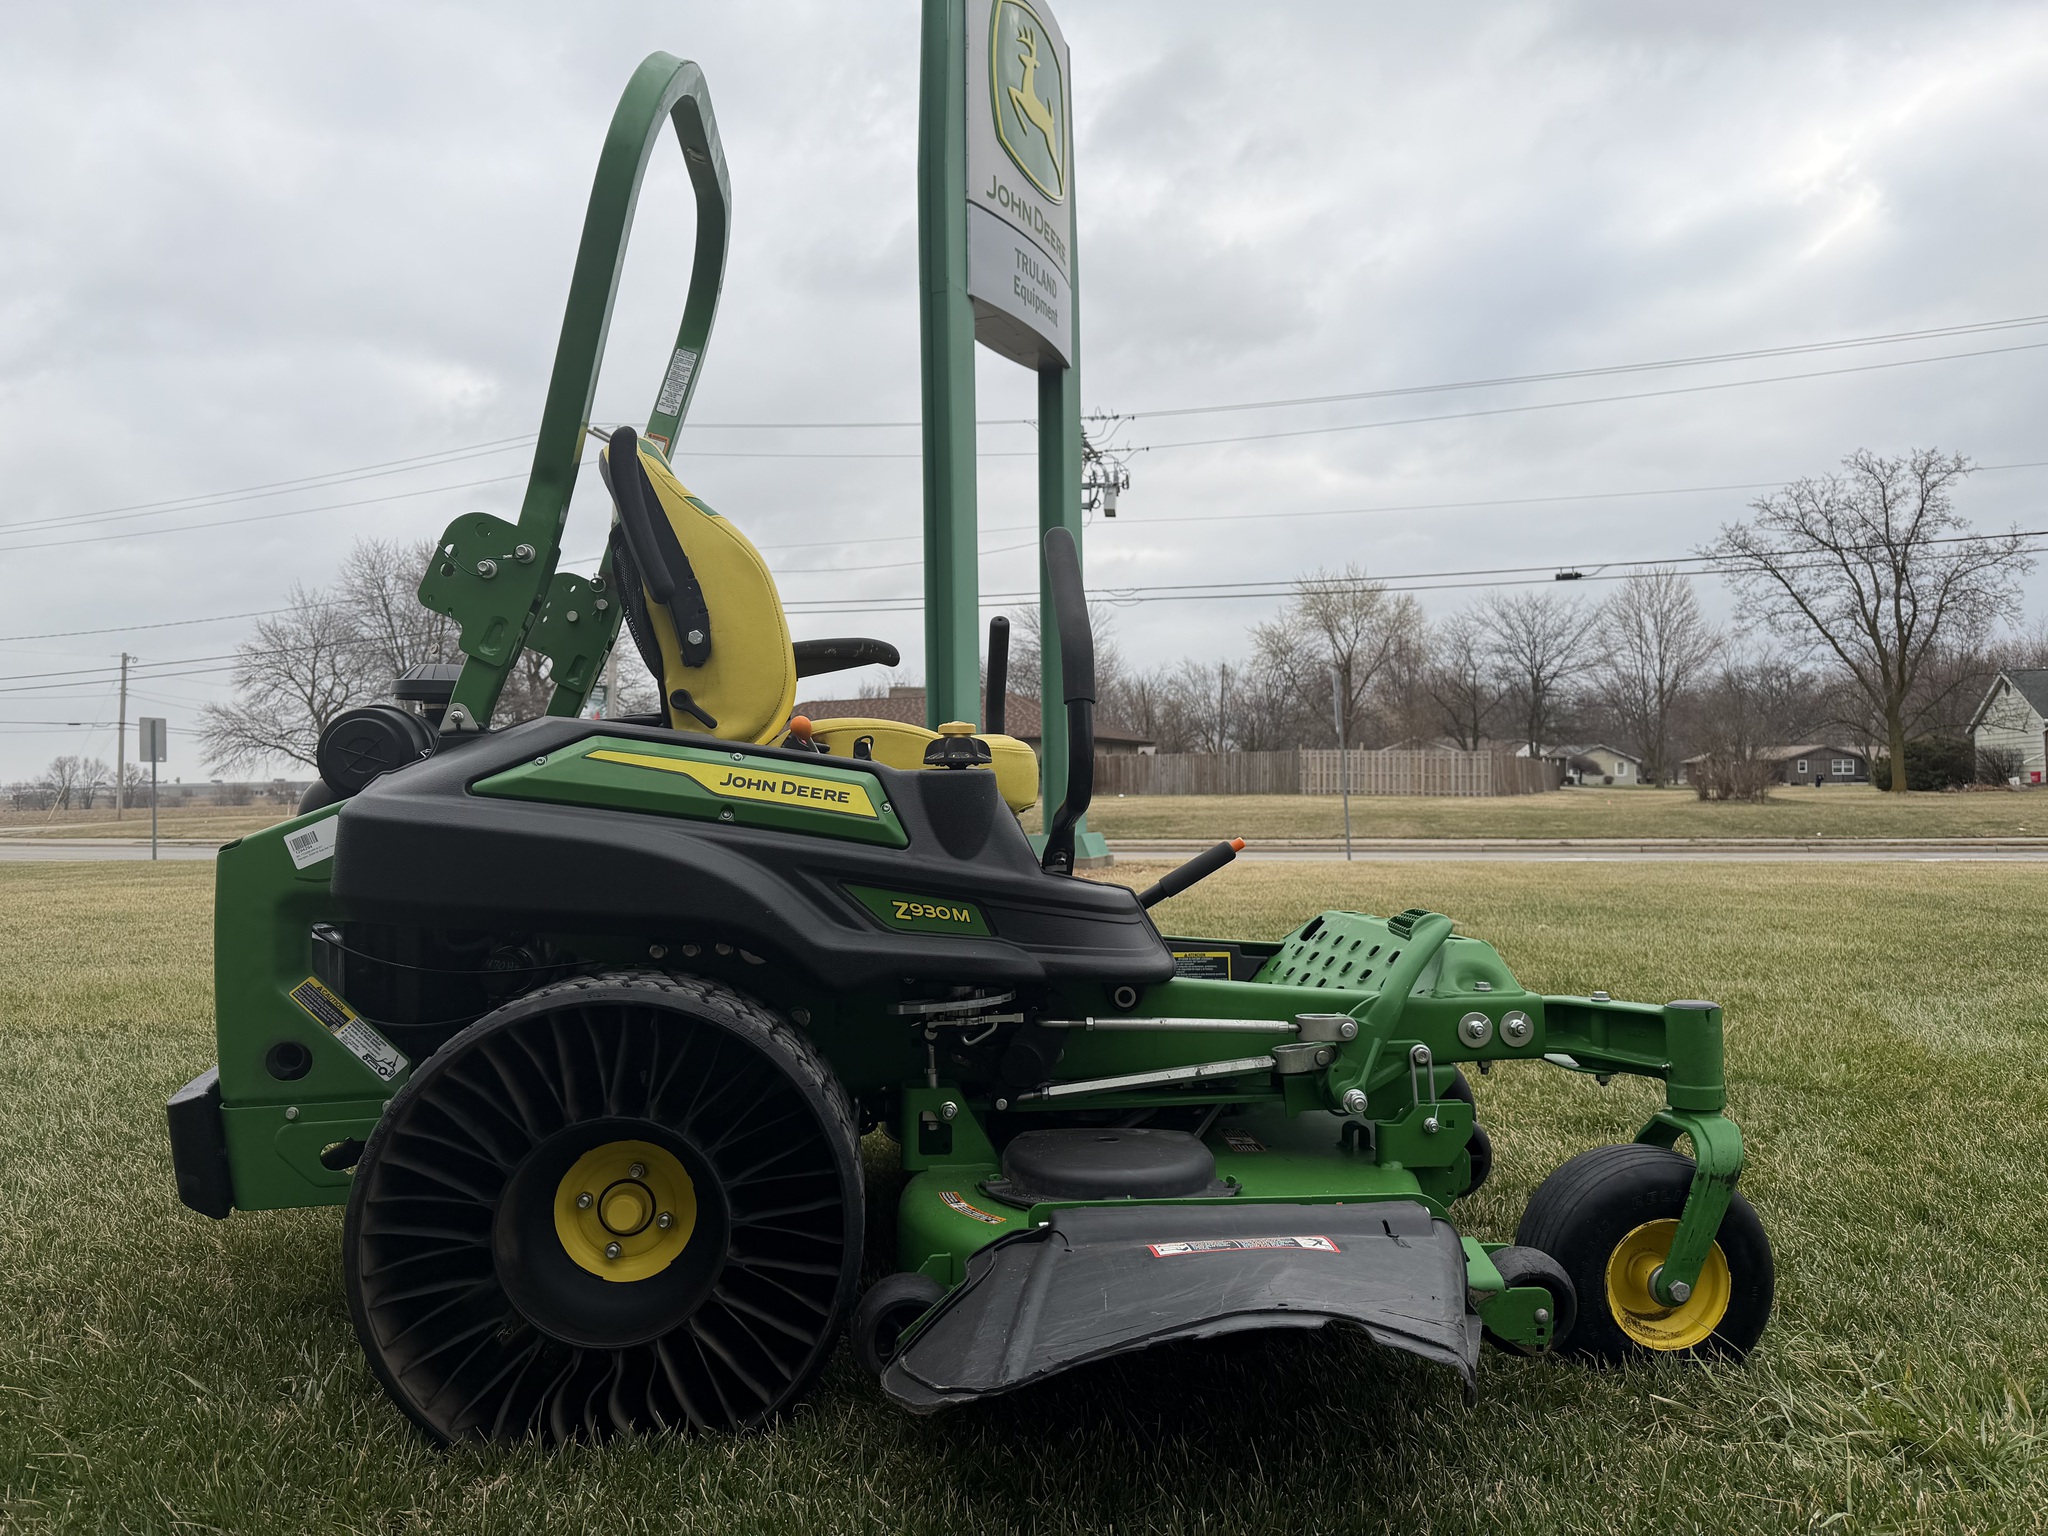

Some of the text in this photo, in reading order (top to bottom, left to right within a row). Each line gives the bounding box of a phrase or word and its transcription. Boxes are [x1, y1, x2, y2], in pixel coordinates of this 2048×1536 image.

[986, 174, 1067, 266] JOHN DEERE
[1014, 247, 1057, 299] TRULAND
[1013, 274, 1059, 328] Equipment
[719, 772, 851, 805] JOHN DEERE
[891, 900, 972, 924] Z930M
[321, 989, 346, 1011] CAUTION
[696, 1006, 771, 1050] MICHELIN
